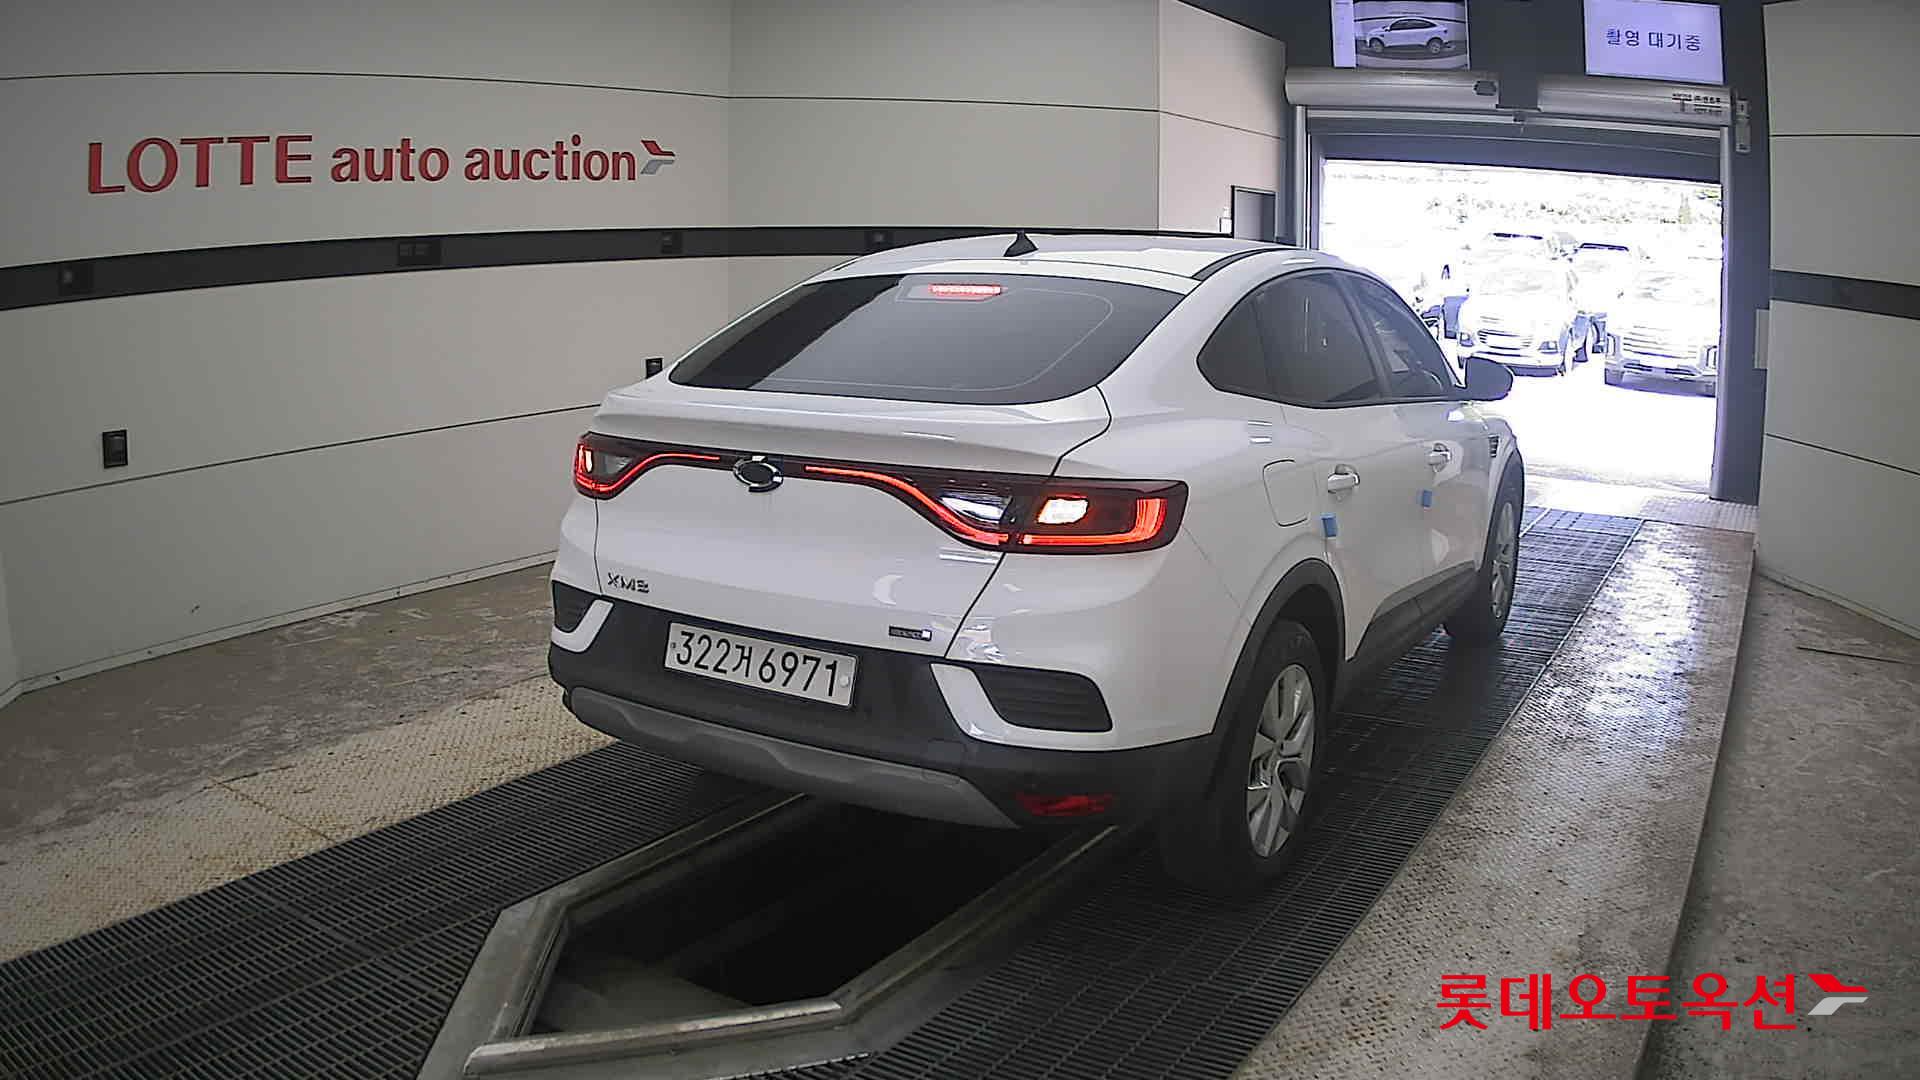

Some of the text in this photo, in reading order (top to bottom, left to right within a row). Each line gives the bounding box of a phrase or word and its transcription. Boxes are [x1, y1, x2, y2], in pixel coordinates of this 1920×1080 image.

[1647, 32, 1702, 52] 대기중
[87, 133, 637, 195] LOTTE auto auction
